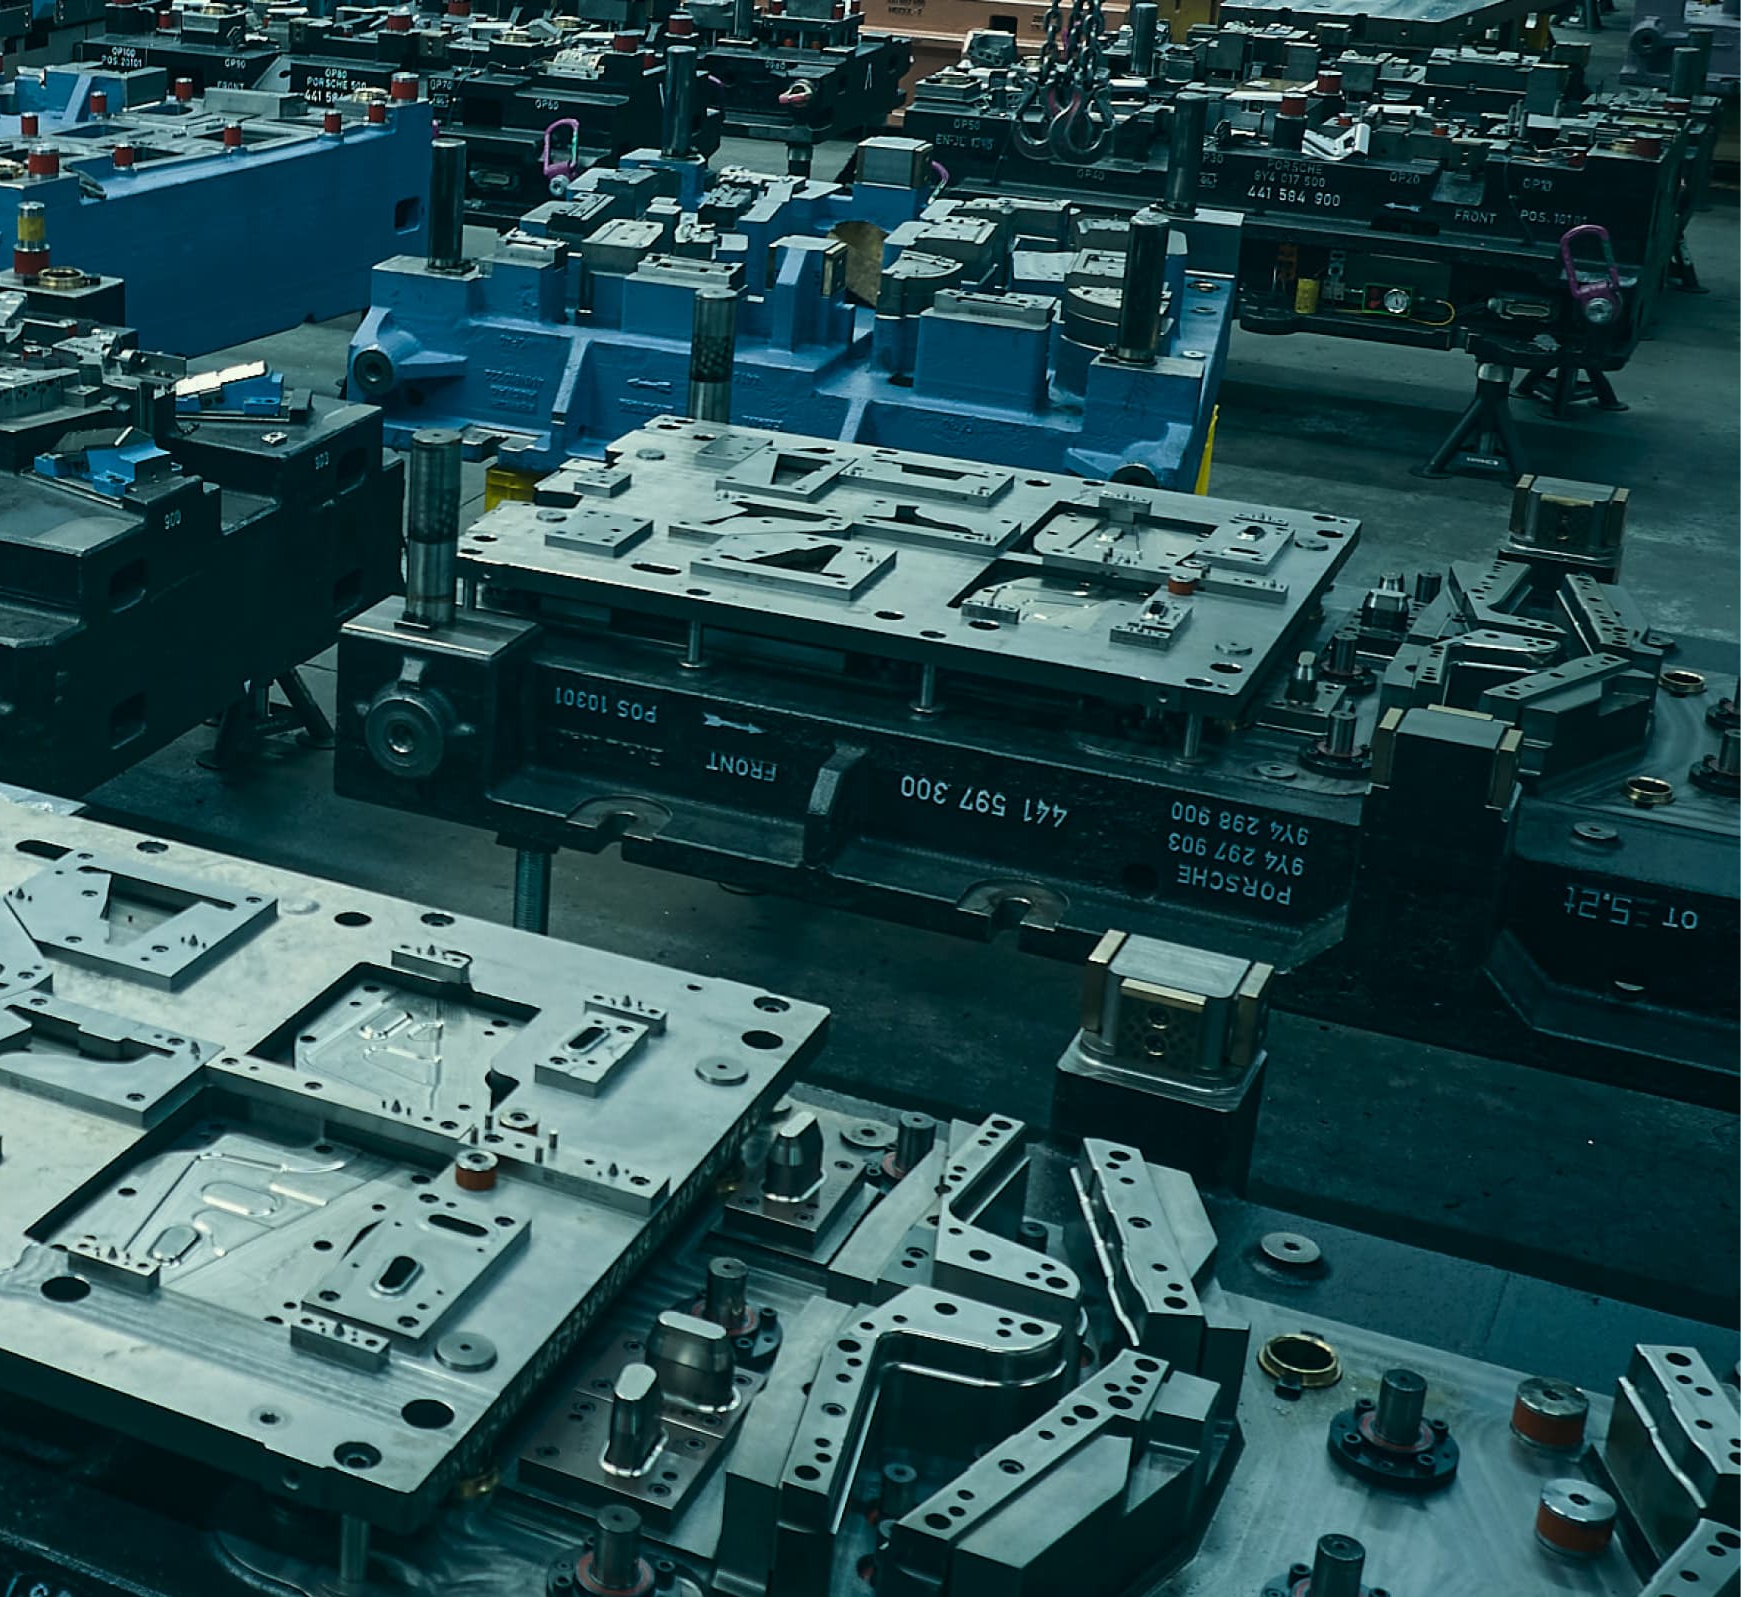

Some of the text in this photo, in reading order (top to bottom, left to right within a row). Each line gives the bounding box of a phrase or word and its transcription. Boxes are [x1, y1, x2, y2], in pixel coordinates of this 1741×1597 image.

[306, 76, 348, 90] PORSCHE
[325, 68, 347, 79] OP80
[304, 89, 322, 103] 441
[1267, 159, 1324, 175] PORSCHE
[1389, 171, 1420, 185] OP20
[1253, 170, 1276, 183] 9Y4
[1304, 175, 1326, 188] 500
[1246, 185, 1341, 207] 441 584 900
[1454, 209, 1497, 225] FRONT
[554, 686, 658, 725] POS 10301
[705, 751, 779, 783] FRONT
[900, 775, 1068, 828] 441 597 300
[1171, 801, 1309, 846] 9Y4 298 900
[1168, 832, 1305, 877] 9Y4 297 903
[1176, 864, 1292, 906] PORSCHE
[1661, 906, 1698, 930] OT
